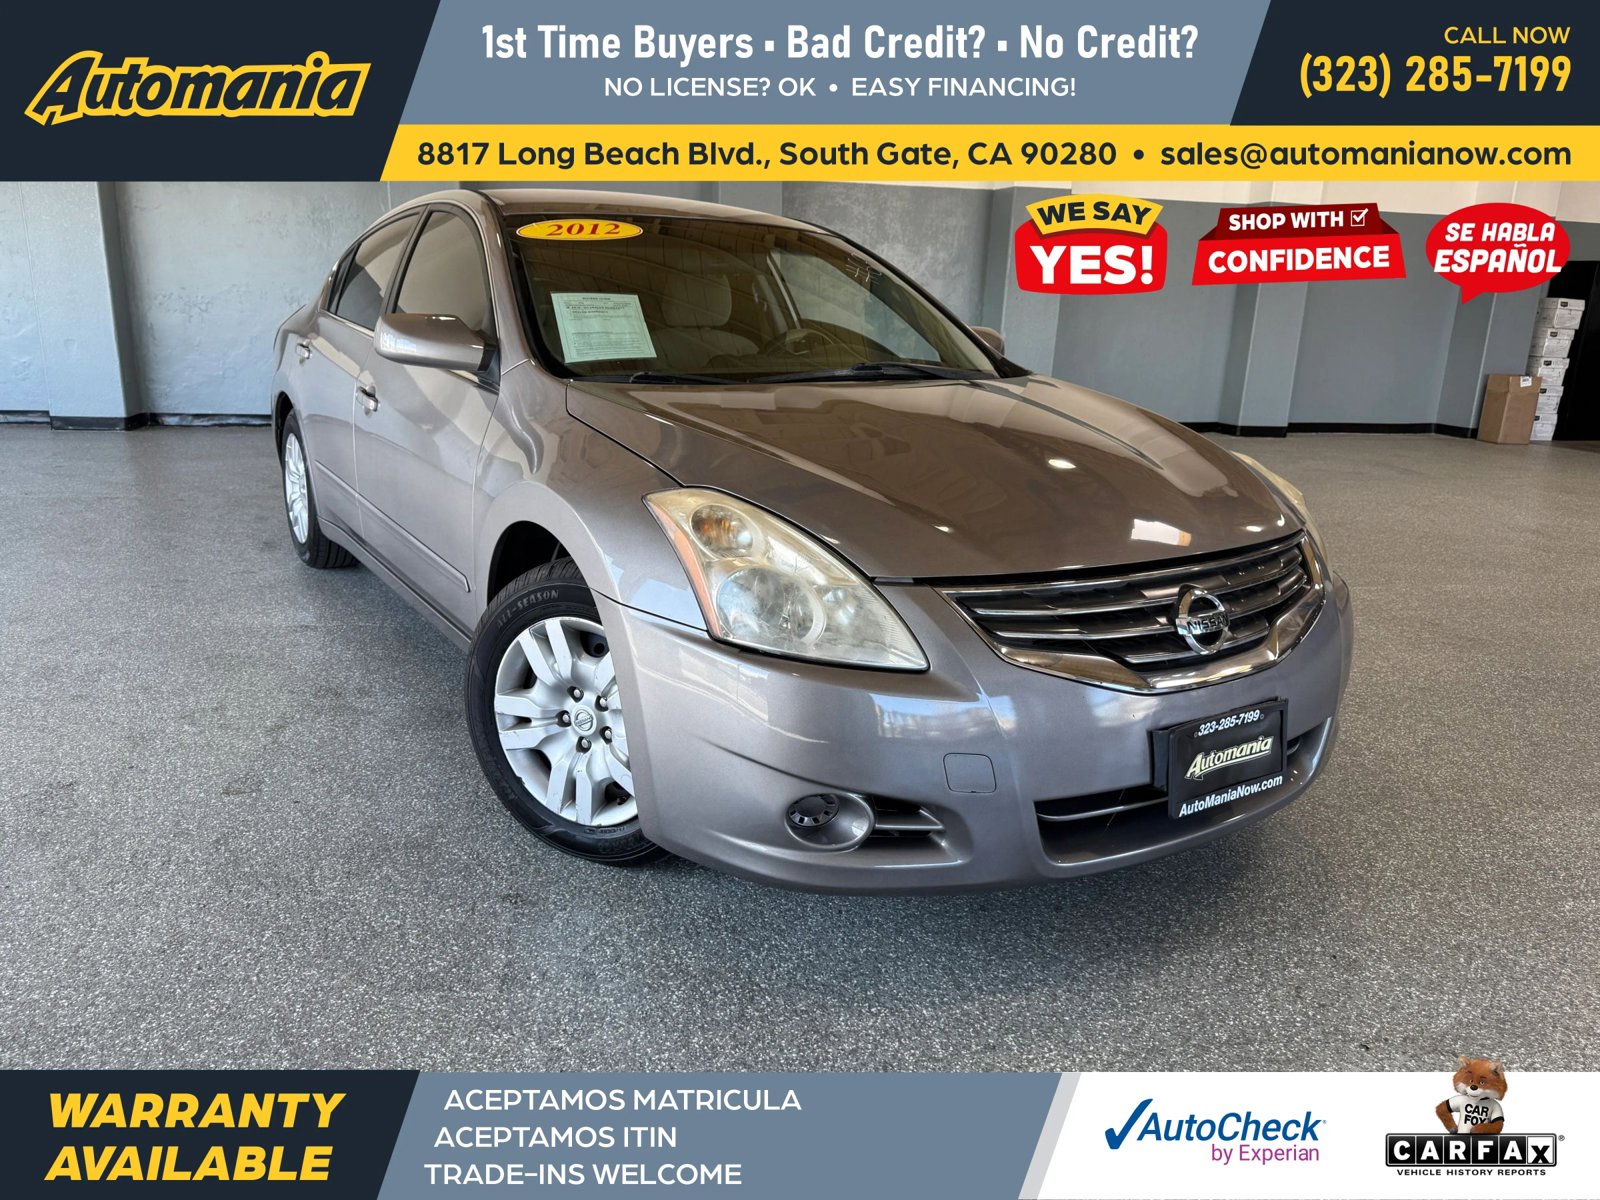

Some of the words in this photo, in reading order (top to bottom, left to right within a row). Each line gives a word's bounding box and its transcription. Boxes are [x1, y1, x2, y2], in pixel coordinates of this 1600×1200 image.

[546, 223, 620, 236] 2012
[1198, 709, 1260, 737] 323-285-7199
[1185, 736, 1273, 779] Automania
[1178, 775, 1283, 817] AutoManiaNow.com
